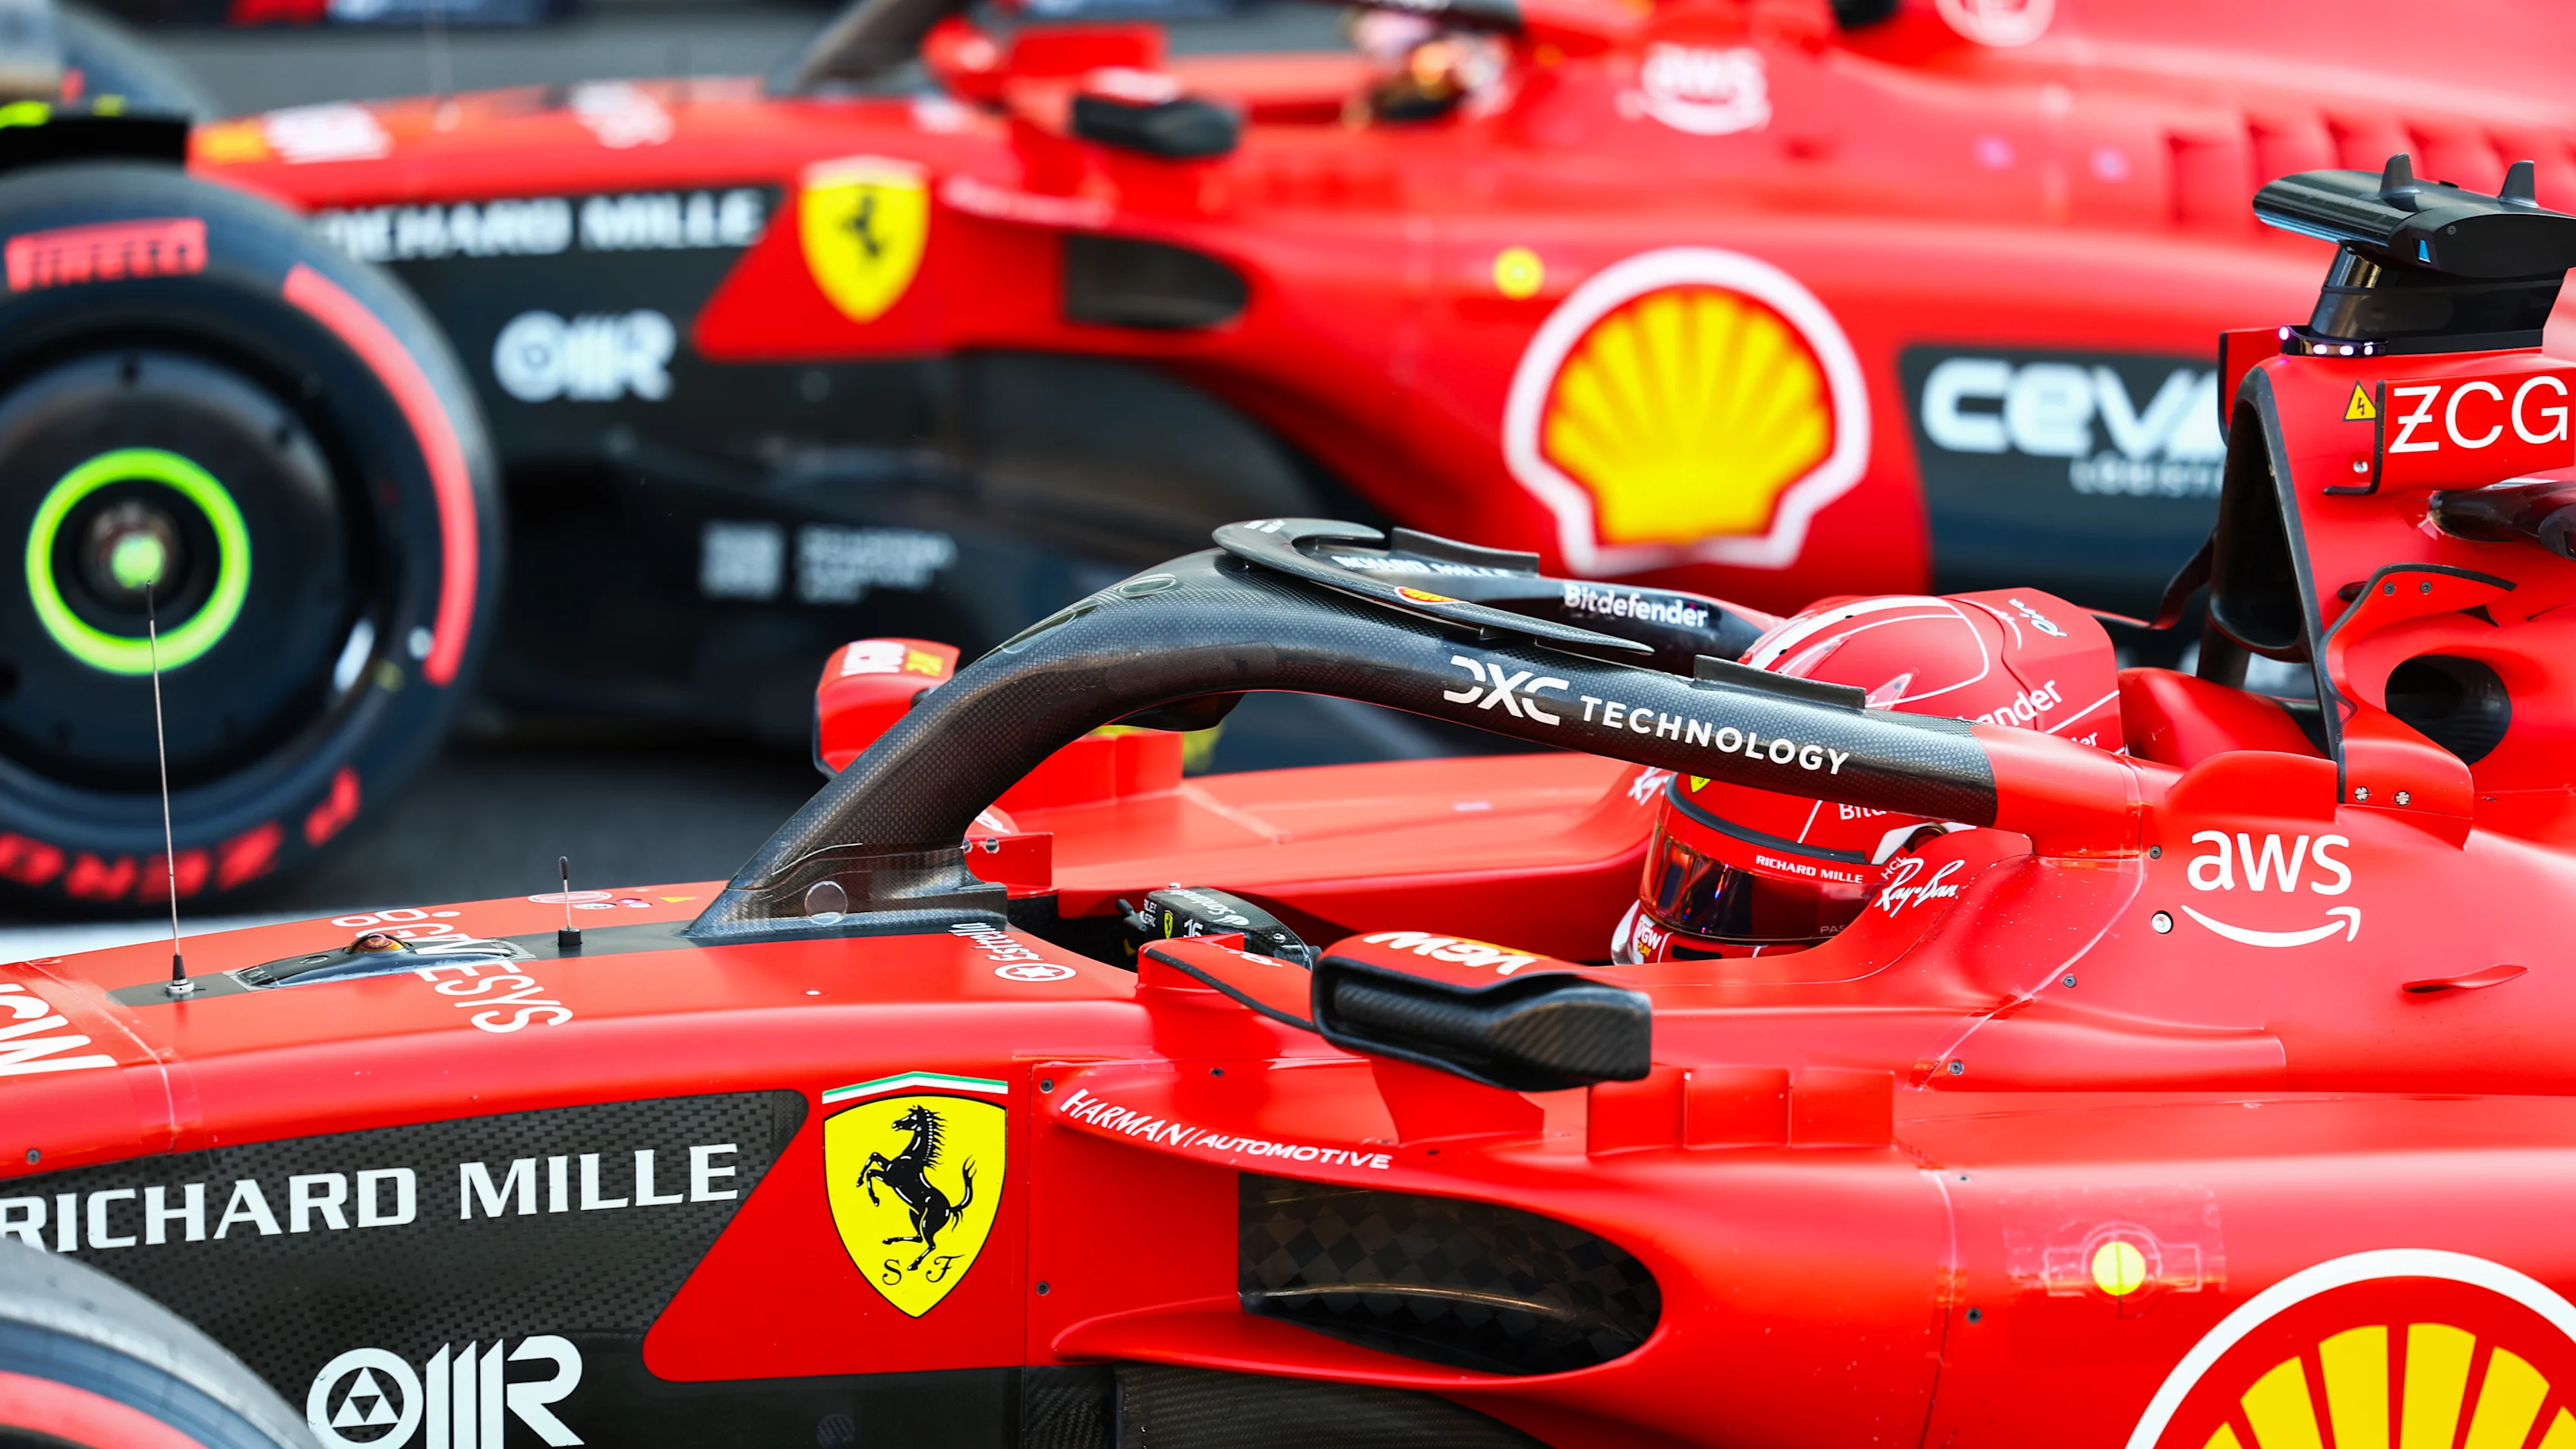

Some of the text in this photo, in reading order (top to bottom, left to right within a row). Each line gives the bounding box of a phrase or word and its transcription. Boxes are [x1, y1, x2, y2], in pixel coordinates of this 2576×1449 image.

[1563, 582, 1709, 628] Bitdefender
[1444, 655, 1851, 775] DXC TECHNOLOGY
[1755, 854, 1864, 884] RICHARD MILLE
[2186, 829, 2352, 895] aws
[0, 1143, 738, 1253] RICHARD MILLE
